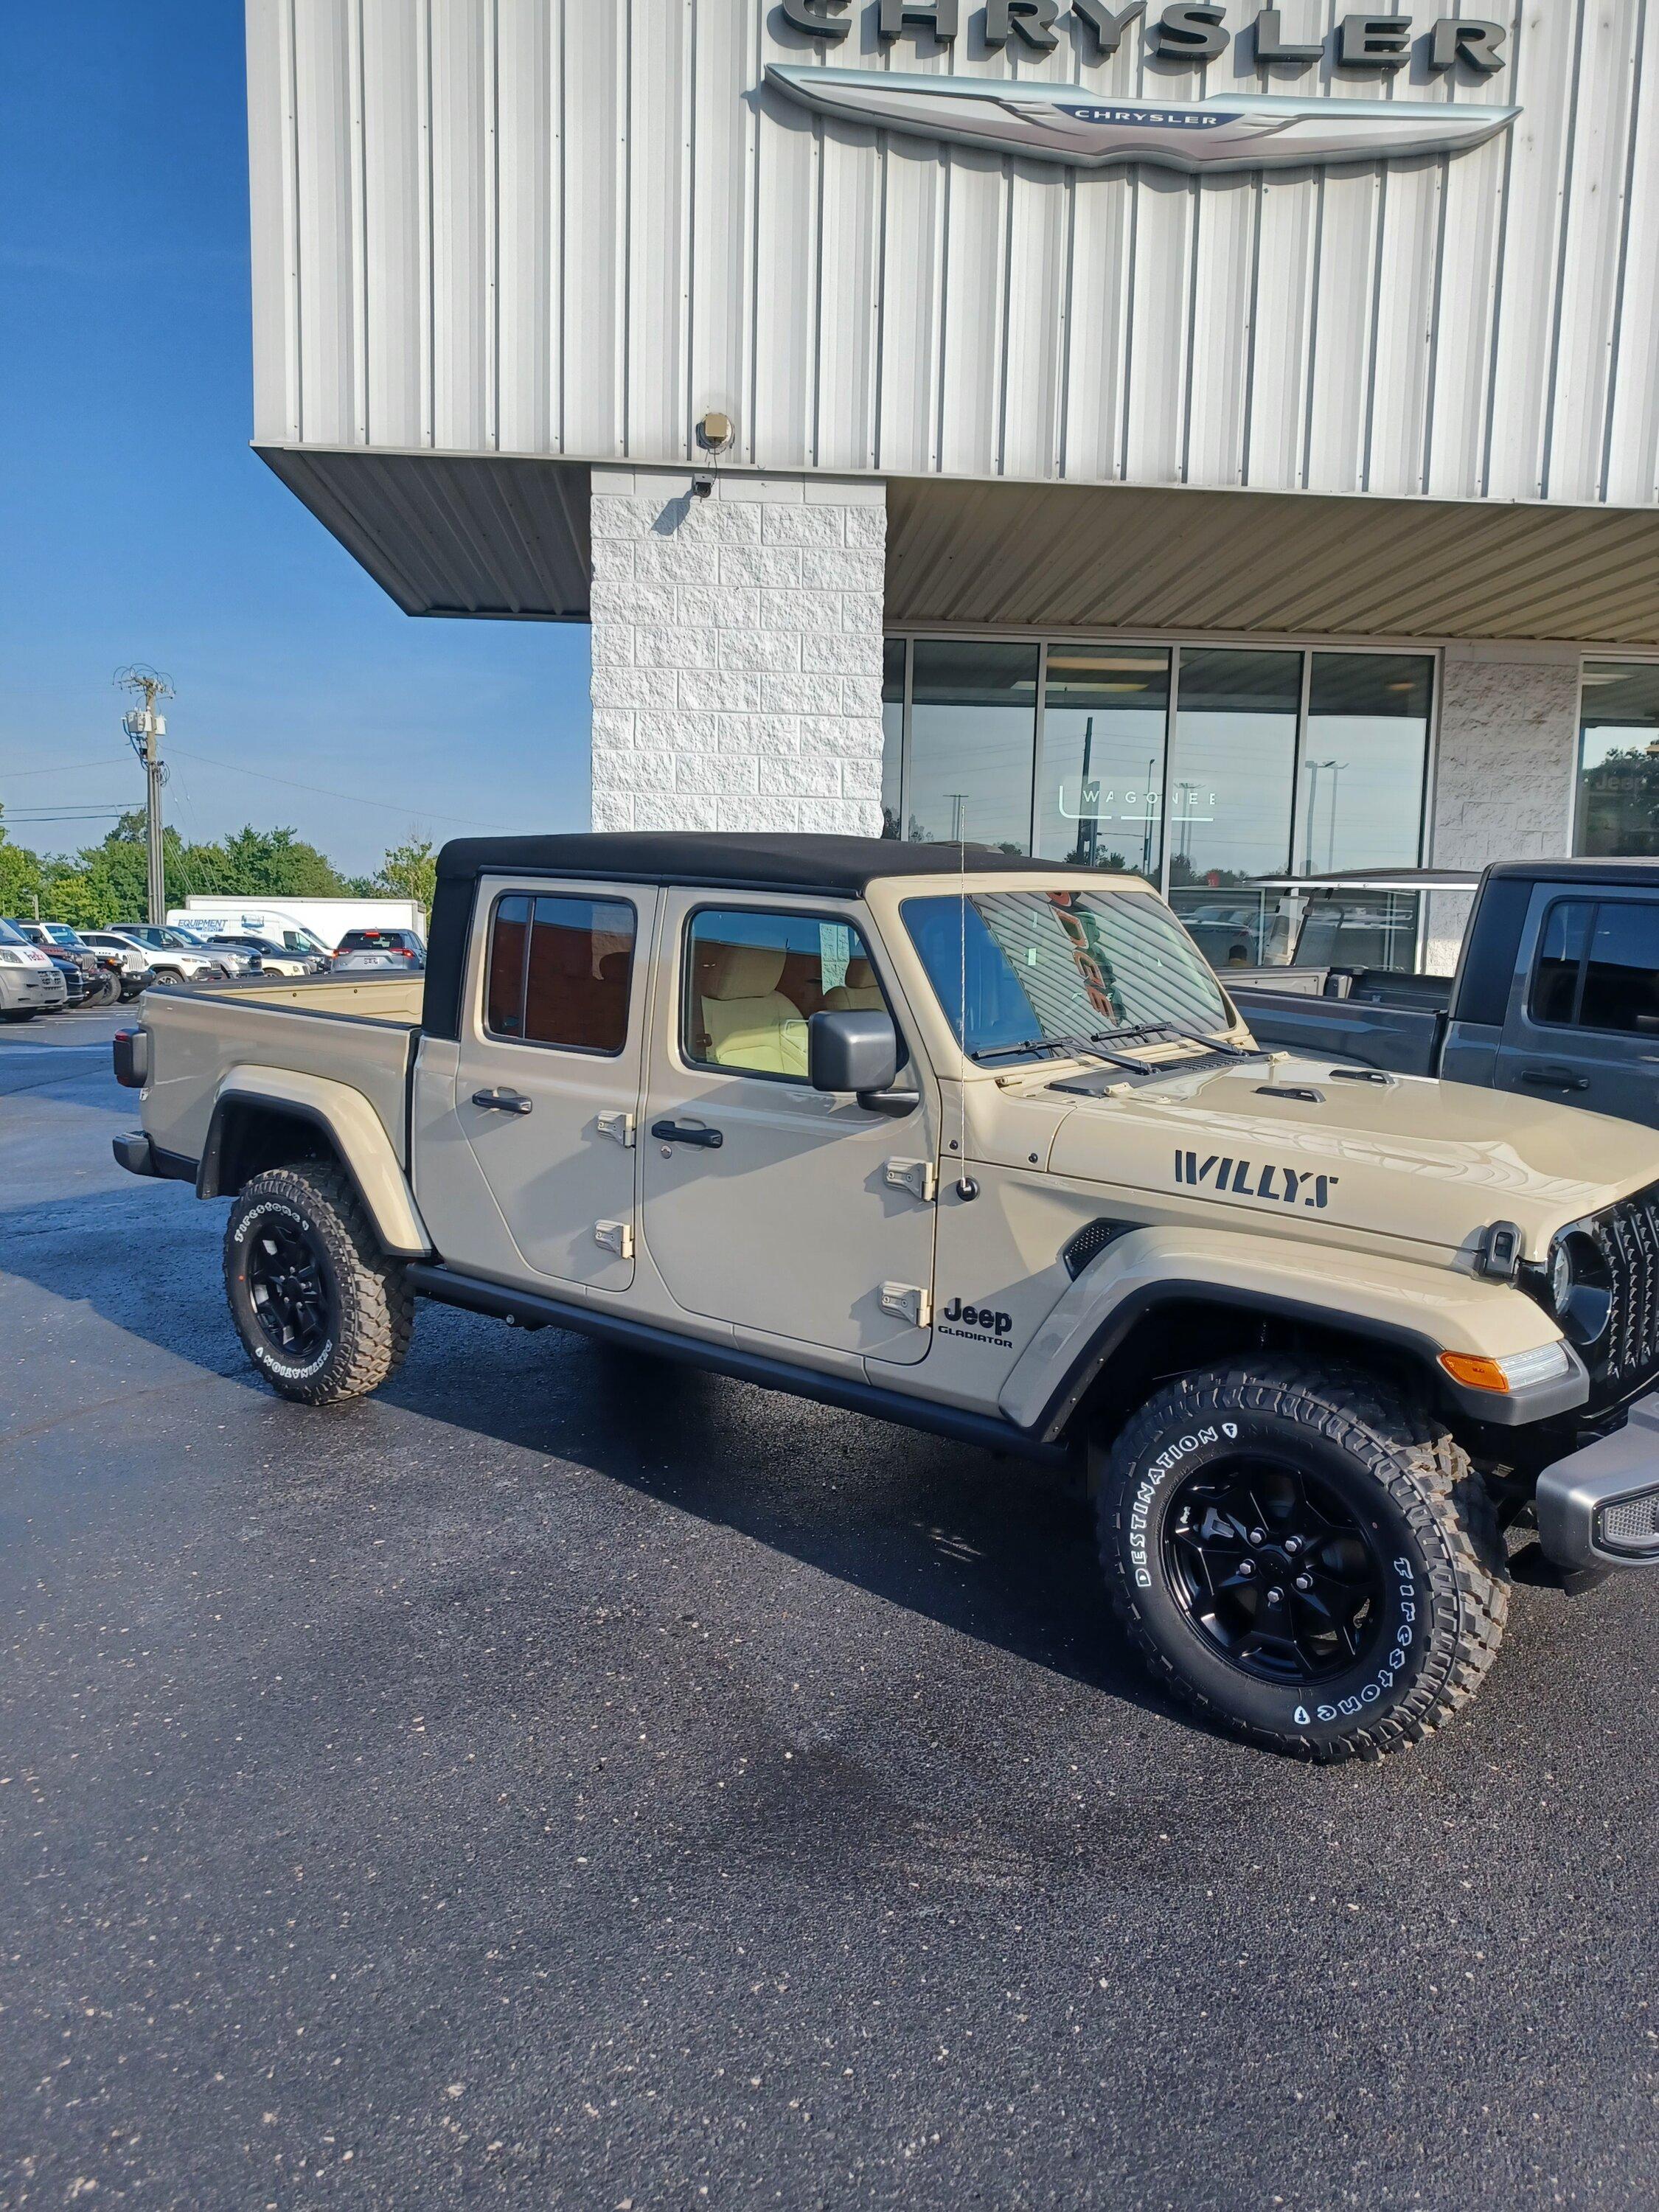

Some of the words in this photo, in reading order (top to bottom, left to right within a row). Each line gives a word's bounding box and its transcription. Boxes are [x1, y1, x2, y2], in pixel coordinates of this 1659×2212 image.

[782, 0, 1506, 72] CHRYSLER
[1075, 110, 1217, 125] CHRYSLER
[178, 919, 228, 928] EQUIPMENT
[1175, 1150, 1339, 1208] WILLYS
[938, 1325, 1013, 1349] GLADIATOR
[944, 1297, 1012, 1336] Jeep
[1130, 1426, 1219, 1587] DESTINATION
[1317, 1557, 1416, 1722] Firestone
